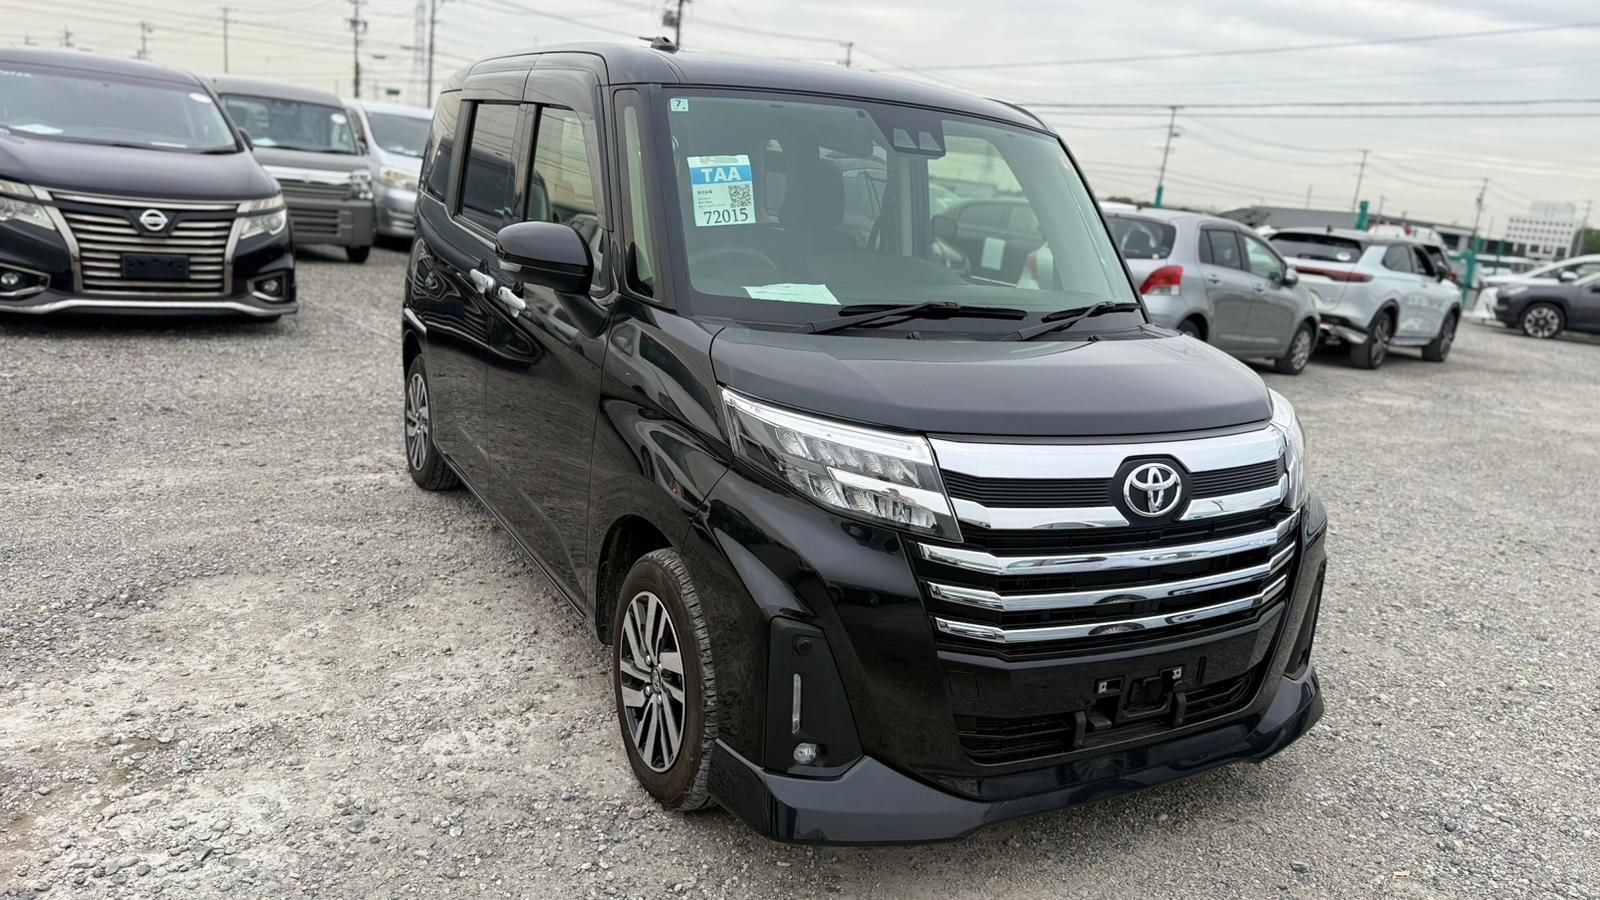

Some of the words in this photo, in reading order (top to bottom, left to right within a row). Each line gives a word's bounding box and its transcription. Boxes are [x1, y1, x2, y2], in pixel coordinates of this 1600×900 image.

[675, 99, 682, 107] 7
[700, 166, 741, 182] TAA
[703, 208, 748, 224] 72015
